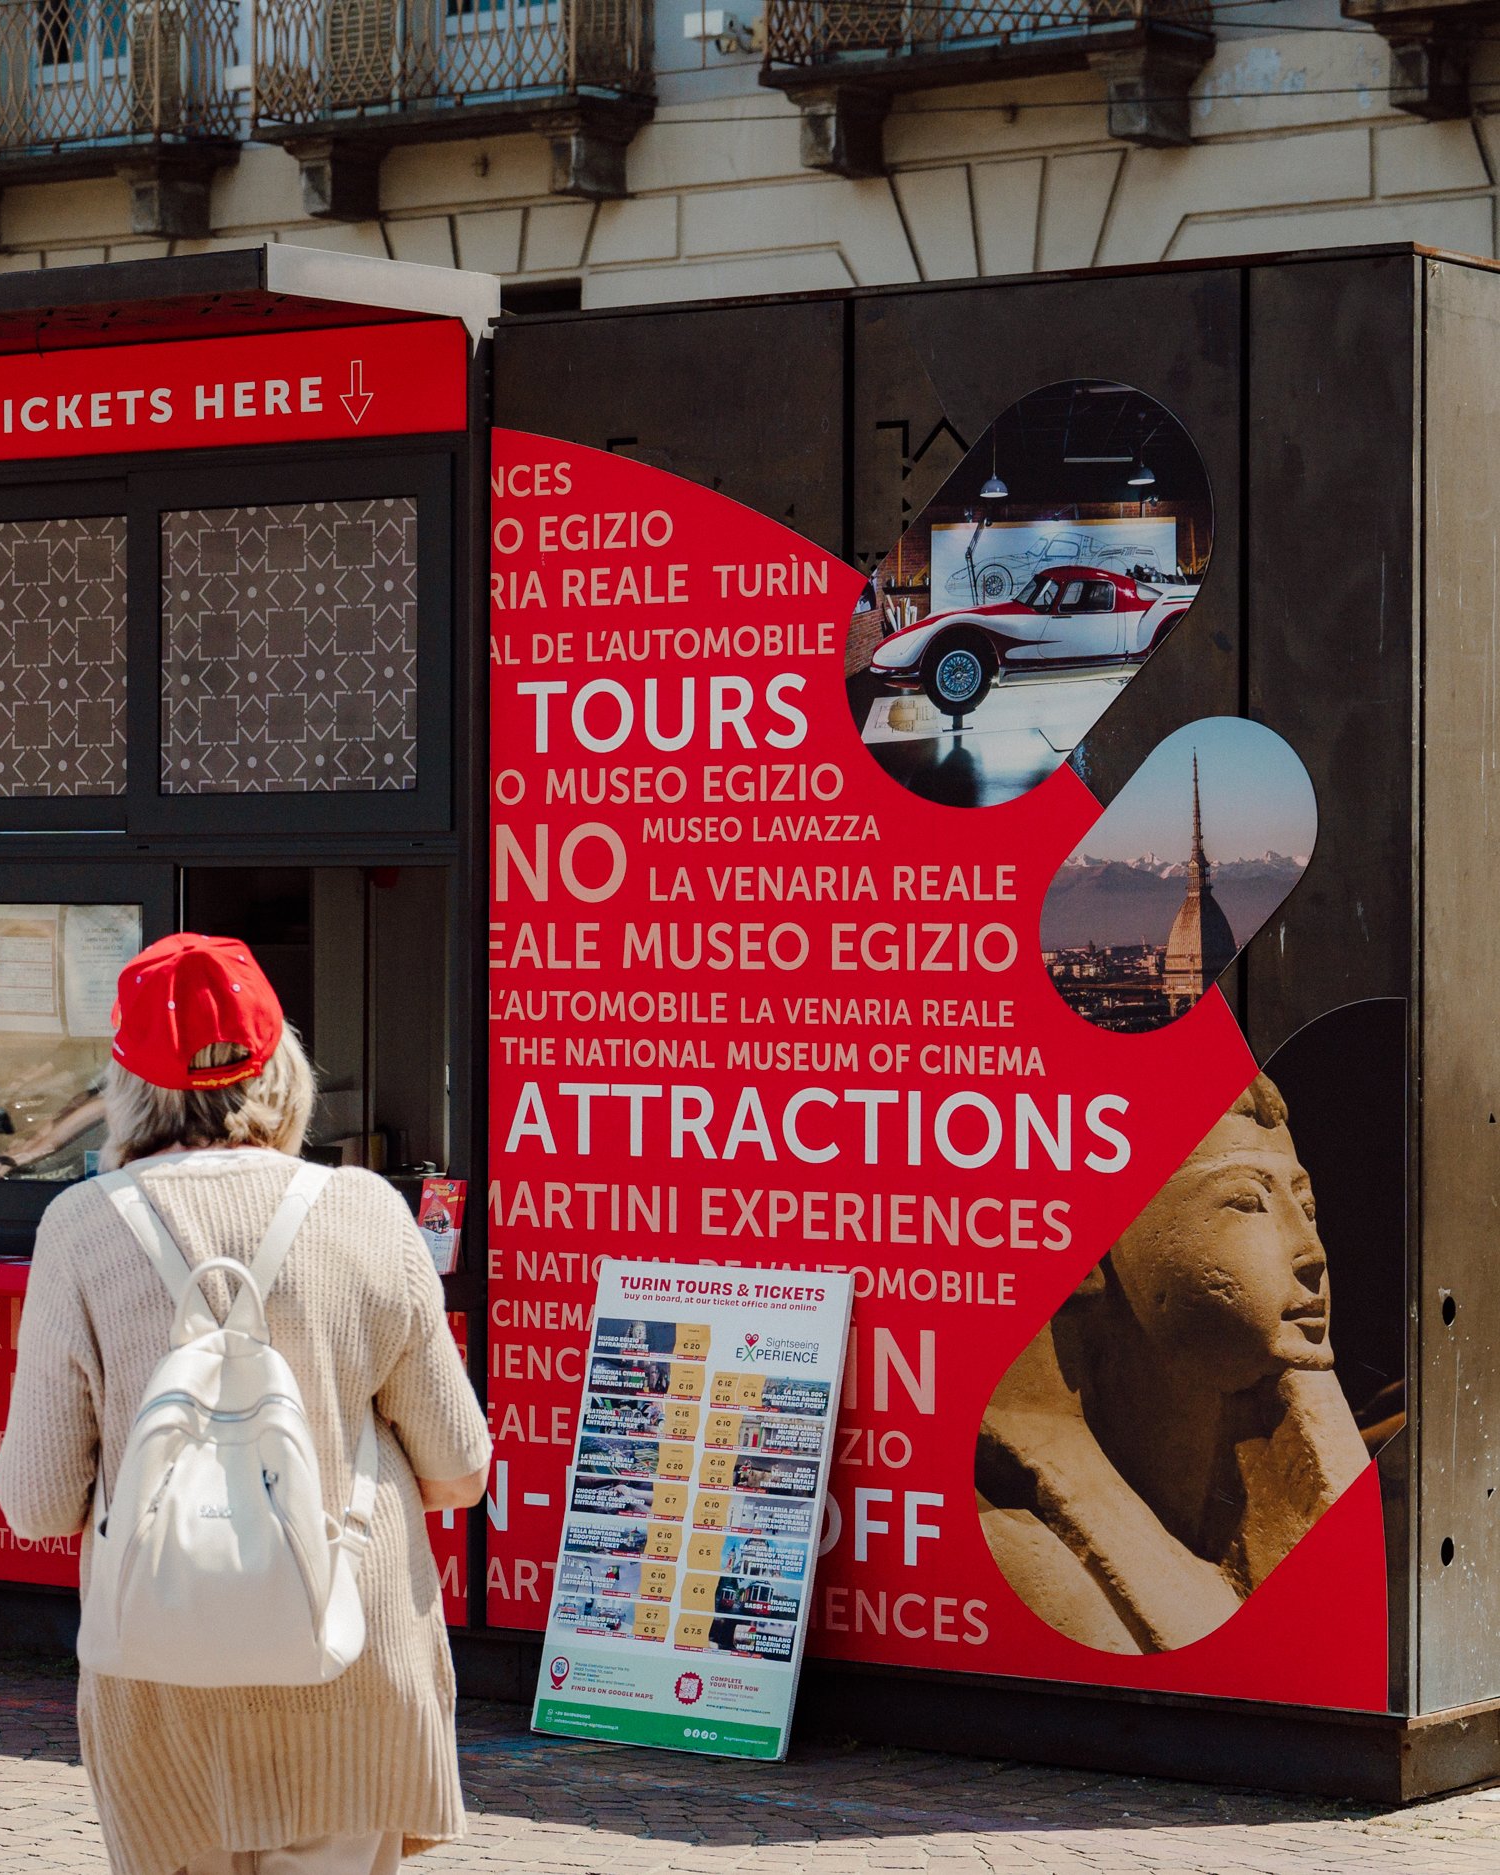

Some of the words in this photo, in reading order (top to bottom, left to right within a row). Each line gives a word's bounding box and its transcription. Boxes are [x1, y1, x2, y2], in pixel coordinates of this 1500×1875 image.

[194, 376, 325, 421] HERE
[539, 510, 674, 552] EGIZIO
[562, 564, 690, 607] REALE
[712, 553, 828, 599] TURÌN
[532, 632, 574, 664] DE
[516, 672, 809, 755] TOURS
[545, 765, 687, 805] MUSEO
[703, 763, 844, 802] EGIZIO
[495, 822, 628, 904] NO
[642, 816, 743, 843] MUSEO
[752, 815, 881, 842] LAVAZZA
[649, 866, 695, 902] LA
[706, 866, 880, 902] VENARIA
[892, 865, 1017, 902] REALE
[622, 922, 810, 971] MUSEO
[831, 922, 1019, 972] EGIZIO
[739, 997, 776, 1024] LA
[784, 998, 912, 1026] VENARIA
[922, 1000, 1015, 1027] REALE
[500, 1036, 556, 1066] THE
[565, 1038, 716, 1070] NATIONAL
[726, 1041, 859, 1073] MUSEUM
[868, 1043, 910, 1074] OF
[918, 1044, 1047, 1077] CINEMA
[504, 1081, 1132, 1173] ATTRACTIONS
[701, 1187, 1074, 1252] EXPERIENCES
[620, 1276, 670, 1292] TURIN
[676, 1279, 733, 1297] TOURS
[737, 1284, 749, 1297] &
[754, 1284, 825, 1302] TICKETS
[624, 1292, 638, 1300] buy
[642, 1293, 653, 1301] on
[655, 1293, 683, 1304] board,
[713, 1298, 740, 1307] ticket
[741, 1299, 768, 1309] office
[770, 1301, 787, 1310] and
[789, 1303, 817, 1312] online
[597, 1341, 628, 1349] ENTRANCE
[735, 1344, 819, 1364] EXPERIENCE
[766, 1336, 820, 1350] Sightseeing
[591, 1379, 622, 1387] ENTRANCE
[623, 1381, 644, 1389] TICKET
[611, 1461, 632, 1469] TICKET
[792, 1483, 814, 1491] TICKET
[573, 1499, 605, 1507] ENTRANCE
[605, 1501, 627, 1509] TICKET
[567, 1538, 599, 1546] ENTRANCE
[599, 1541, 620, 1549] TICKET
[781, 1565, 803, 1573] TICKET
[767, 1605, 796, 1613] SUPERGA
[755, 1646, 790, 1655] BARATTINO
[710, 1675, 742, 1684] COMPLETE
[608, 1689, 634, 1697] GOOGLE
[634, 1692, 654, 1700] MAPS
